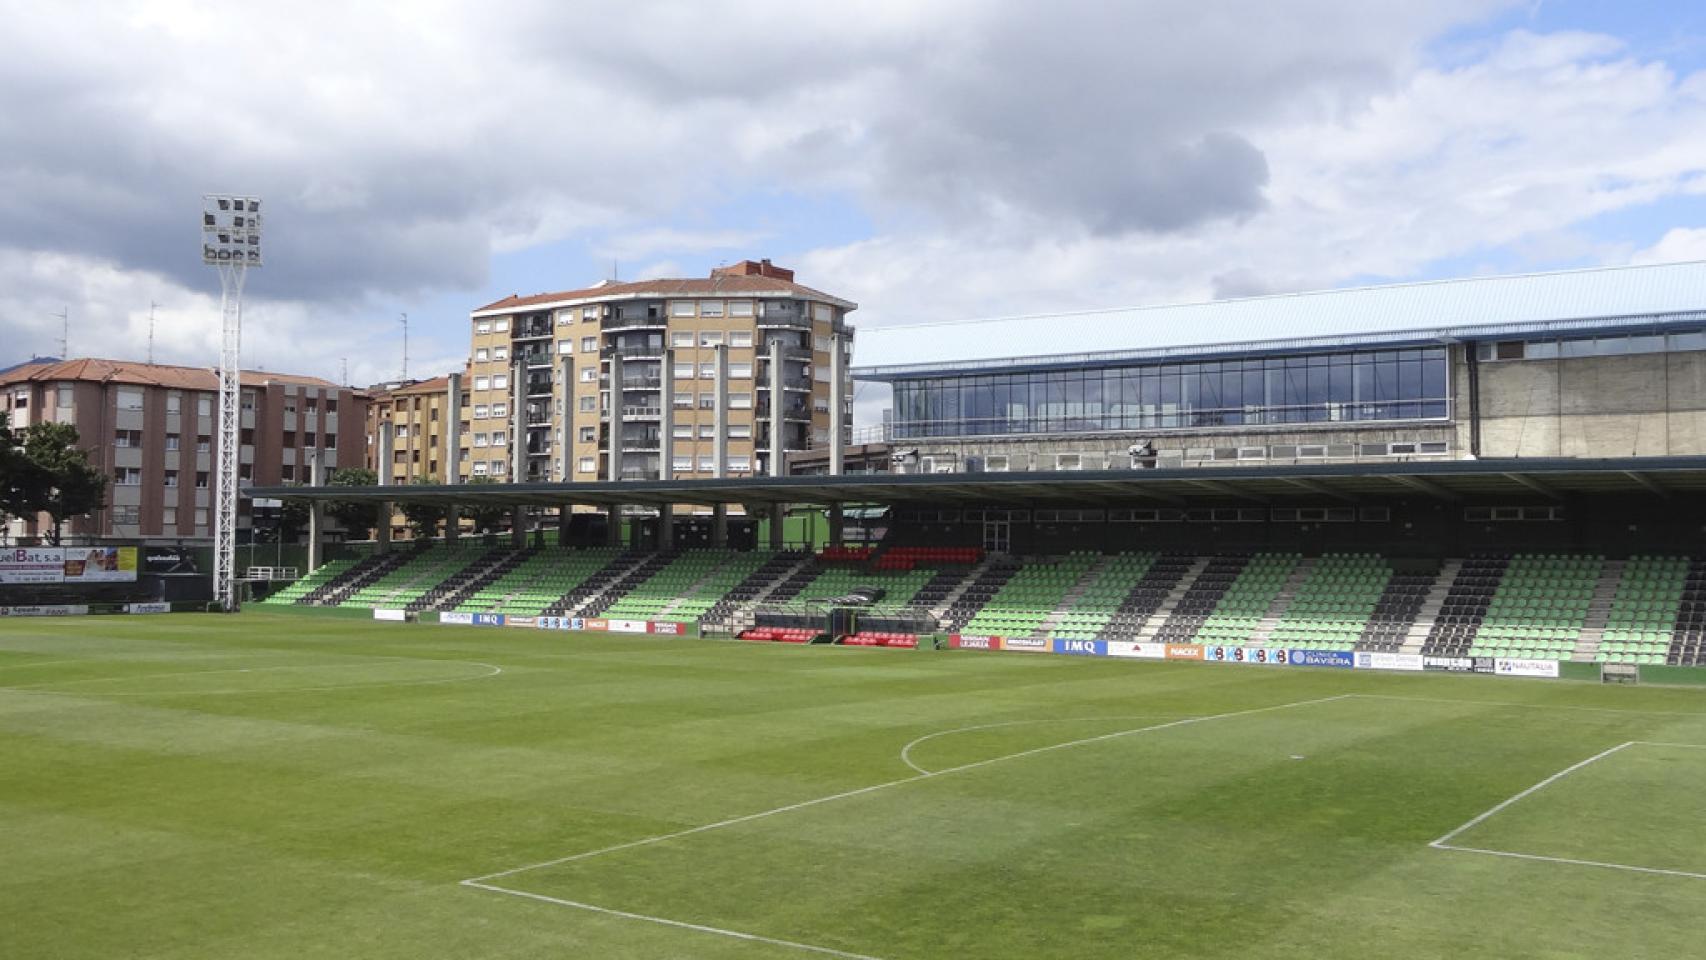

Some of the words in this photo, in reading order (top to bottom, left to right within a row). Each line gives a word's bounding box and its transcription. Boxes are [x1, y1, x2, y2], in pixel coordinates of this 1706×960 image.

[479, 613, 498, 625] IMQ
[1064, 640, 1096, 654] IMQ
[1305, 658, 1352, 666] BAVIERA
[1512, 661, 1553, 671] NAUTALIA
